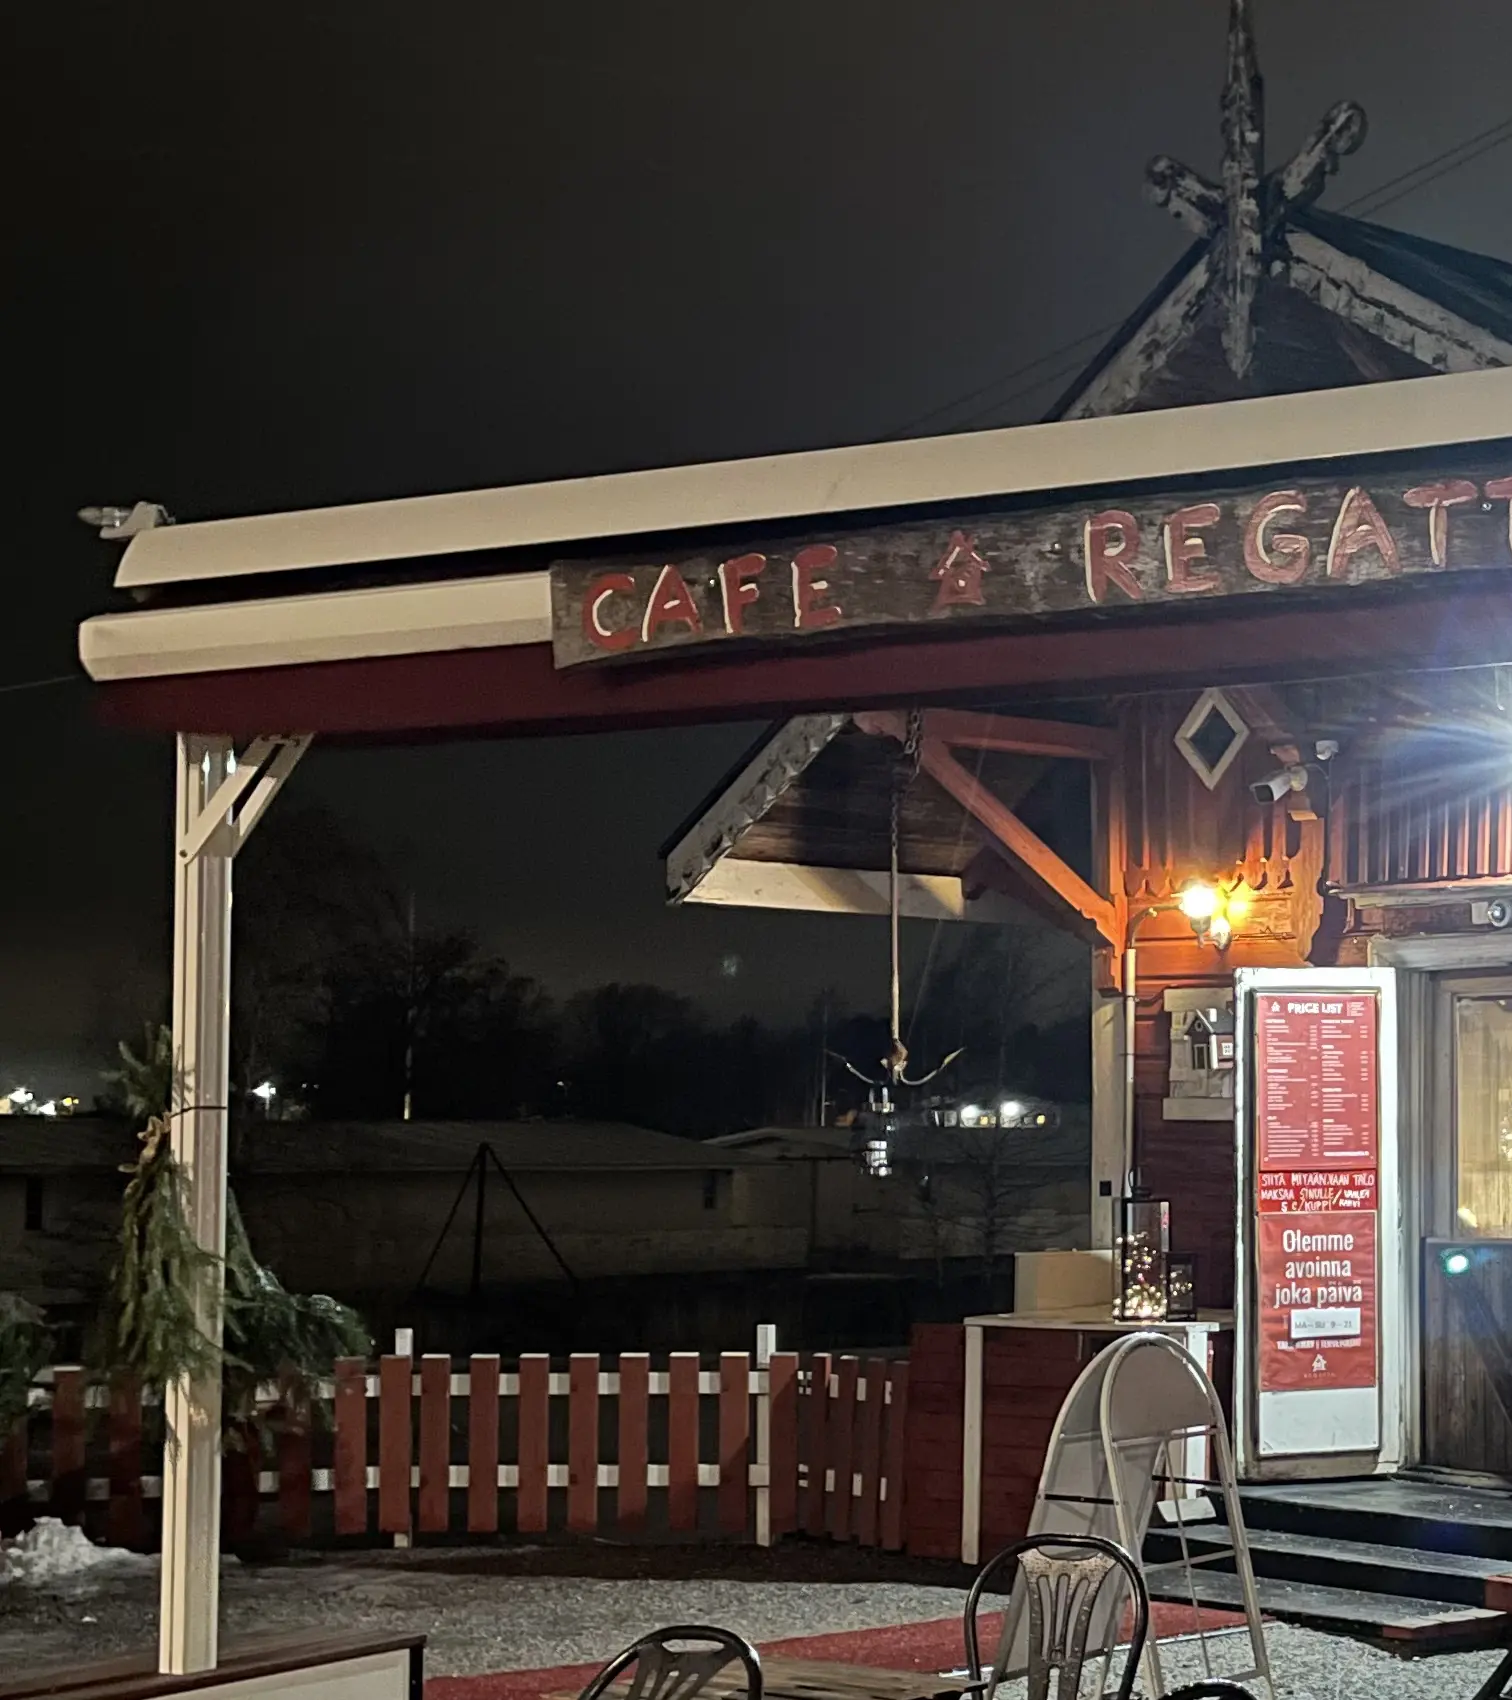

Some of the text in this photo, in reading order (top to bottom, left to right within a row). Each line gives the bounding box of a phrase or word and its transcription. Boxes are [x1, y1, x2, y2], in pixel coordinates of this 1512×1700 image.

[582, 543, 842, 650] CAFE
[1287, 1002, 1319, 1014] PRICE
[1321, 1002, 1343, 1014] LIST
[1261, 1188, 1295, 1200] MAKSAA
[1282, 1229, 1354, 1253] Olemme
[1285, 1255, 1352, 1279] avoinna
[1273, 1279, 1363, 1309] joka päivä
